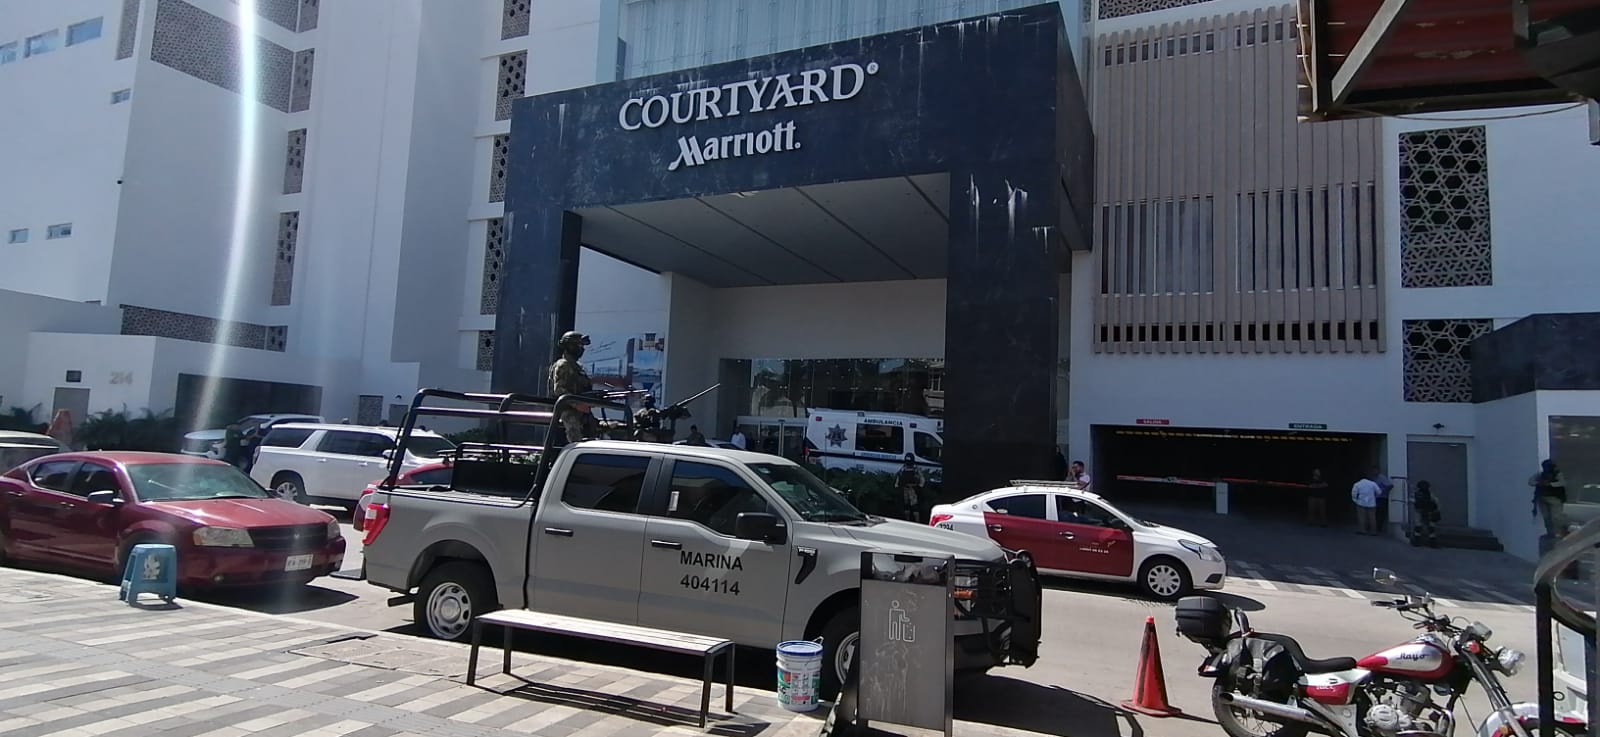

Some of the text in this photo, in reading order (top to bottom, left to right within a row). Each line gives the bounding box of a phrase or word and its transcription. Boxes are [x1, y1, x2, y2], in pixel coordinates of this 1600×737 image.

[667, 120, 798, 171] Marriott
[863, 418, 903, 426] AMBULANCIA
[680, 550, 743, 571] MARINA
[680, 574, 740, 596] 404114
[1397, 652, 1430, 661] Rayo
